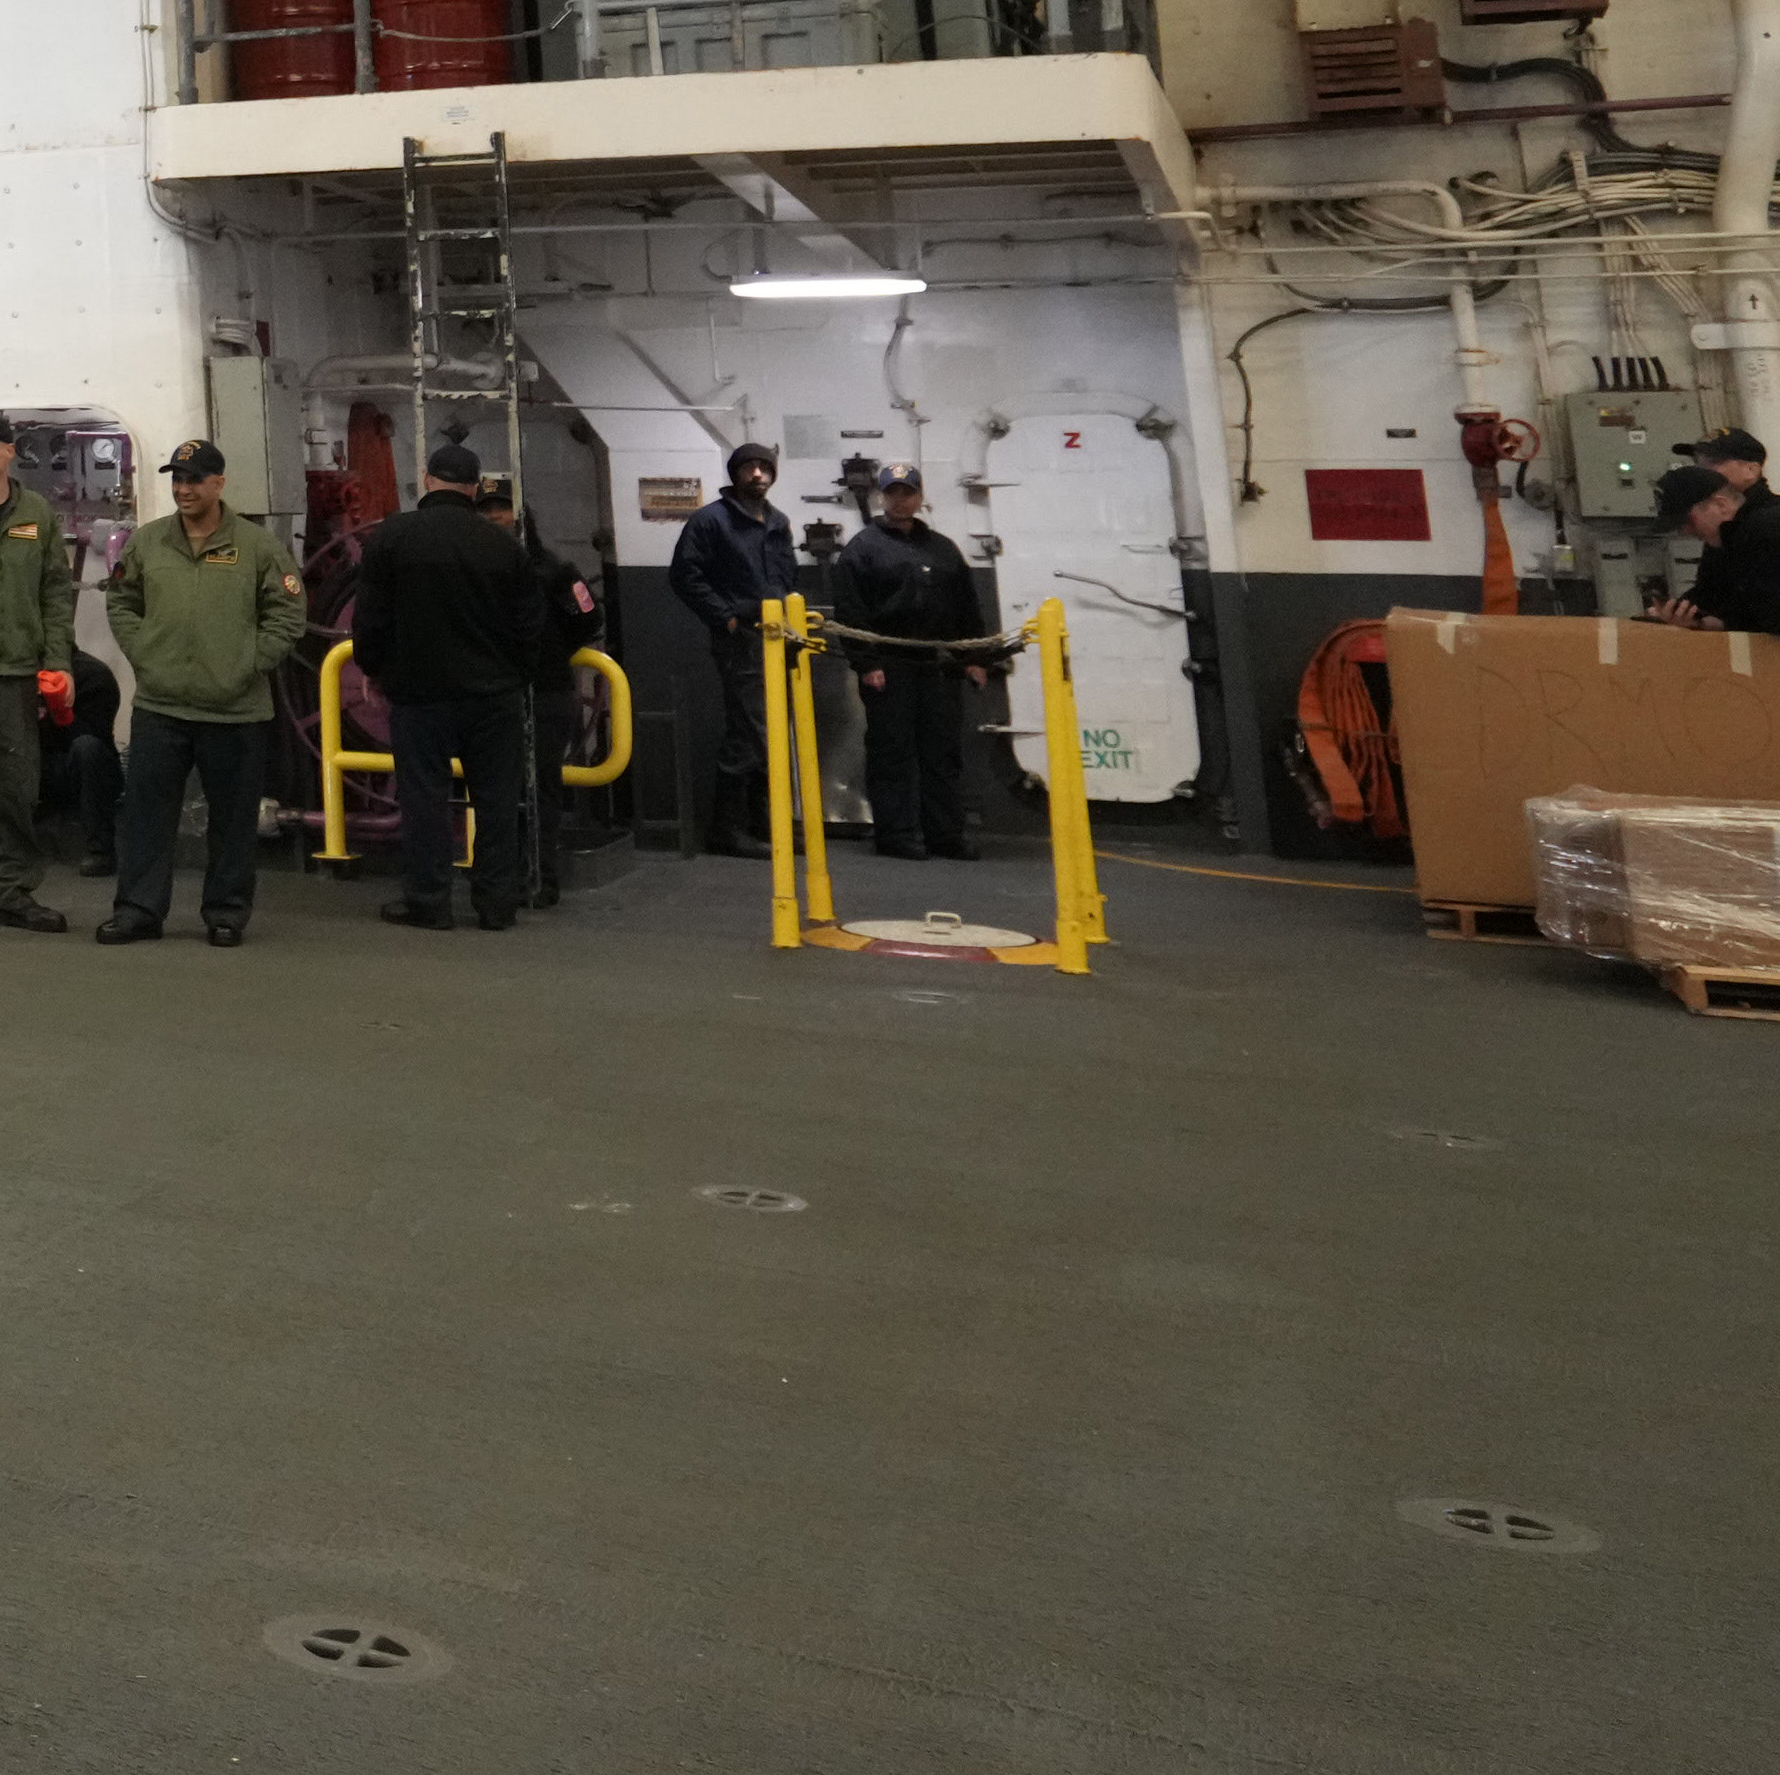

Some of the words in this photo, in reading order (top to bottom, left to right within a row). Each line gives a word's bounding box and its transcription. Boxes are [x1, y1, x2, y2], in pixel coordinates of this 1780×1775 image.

[1063, 432, 1082, 448] Z
[1477, 665, 1774, 784] DRMO
[1083, 730, 1121, 749] NO
[1081, 750, 1132, 770] EXIT
